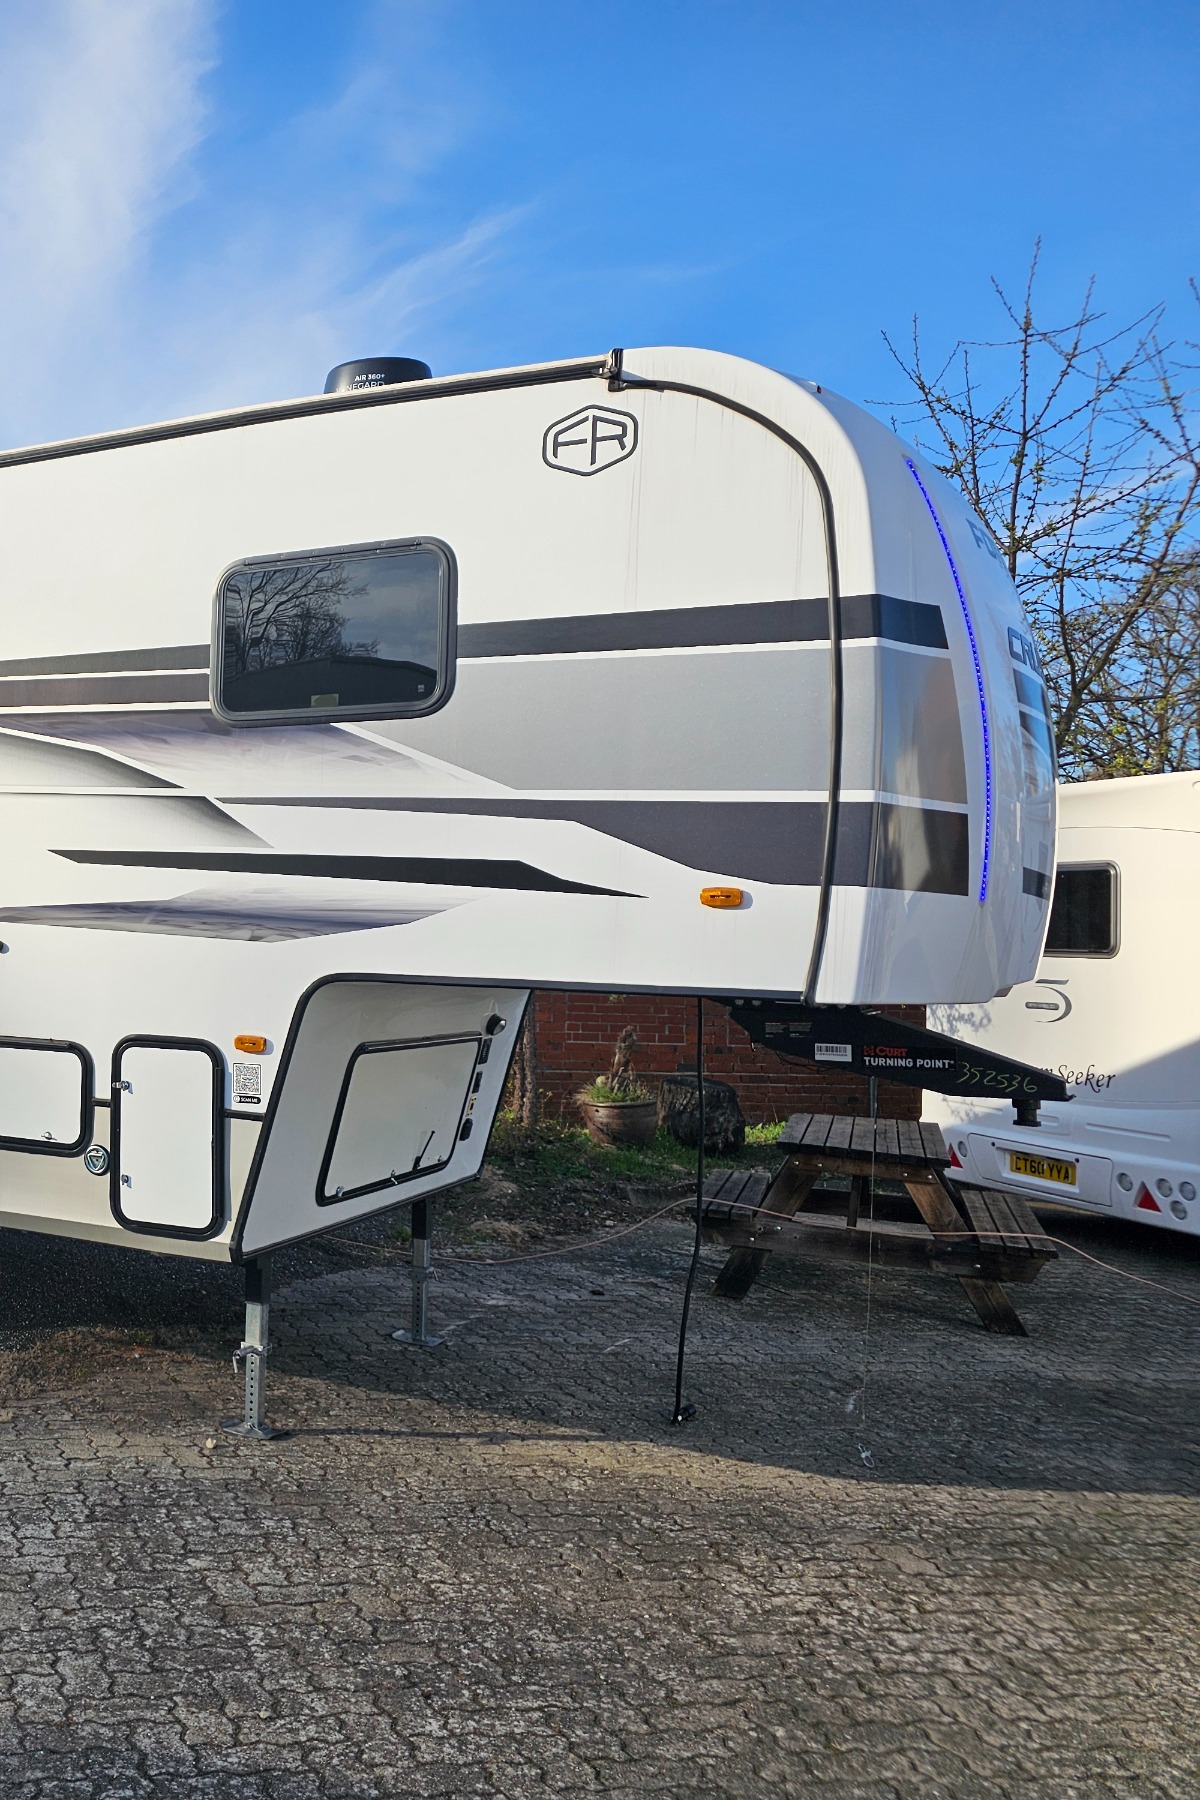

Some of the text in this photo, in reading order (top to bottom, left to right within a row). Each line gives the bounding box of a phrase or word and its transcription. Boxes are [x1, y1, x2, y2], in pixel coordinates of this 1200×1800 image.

[336, 381, 384, 392] NEGARD
[876, 1046, 908, 1057] CURT
[863, 1056, 951, 1069] TURNING POINT
[956, 1062, 1038, 1093] 352536
[1058, 1064, 1116, 1094] Seeker
[1047, 1162, 1070, 1182] YYA
